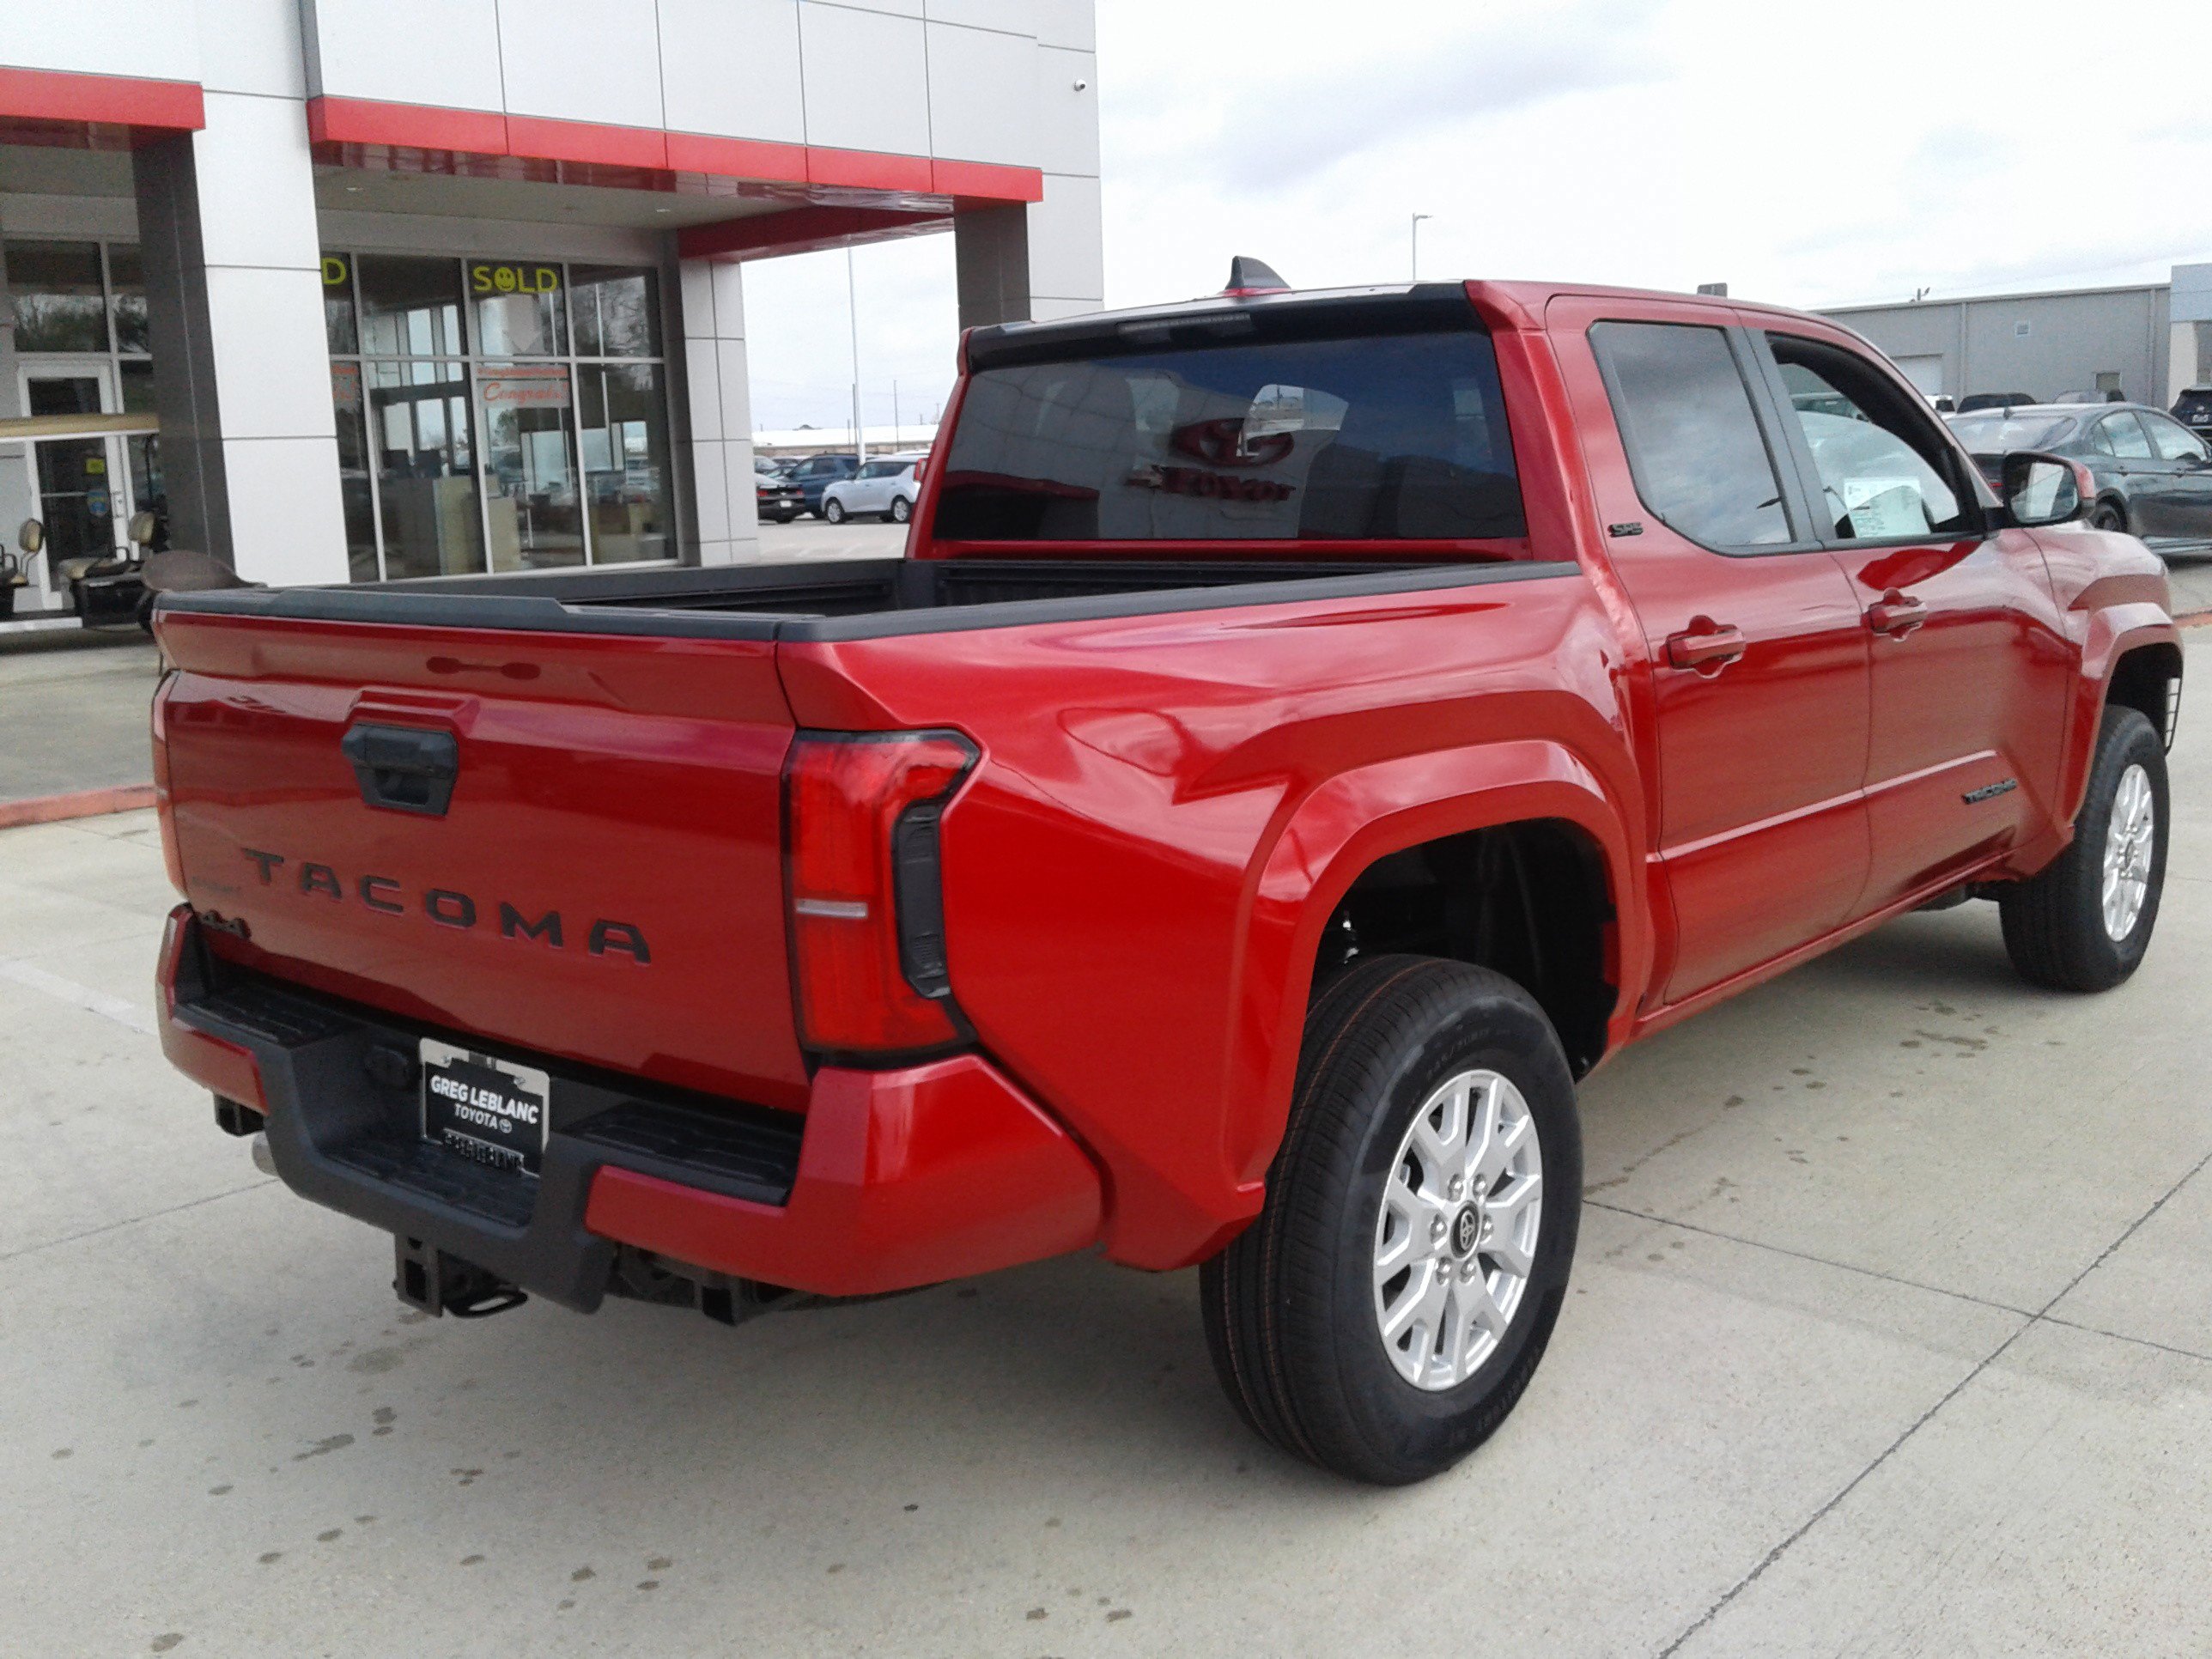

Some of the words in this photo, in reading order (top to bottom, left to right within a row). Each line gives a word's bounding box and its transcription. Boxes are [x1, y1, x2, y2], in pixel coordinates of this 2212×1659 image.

[241, 848, 652, 965] TACOMA
[431, 1075, 468, 1102] GREG
[471, 1087, 539, 1124] LEBLANC
[454, 1104, 497, 1129] TOYOTA
